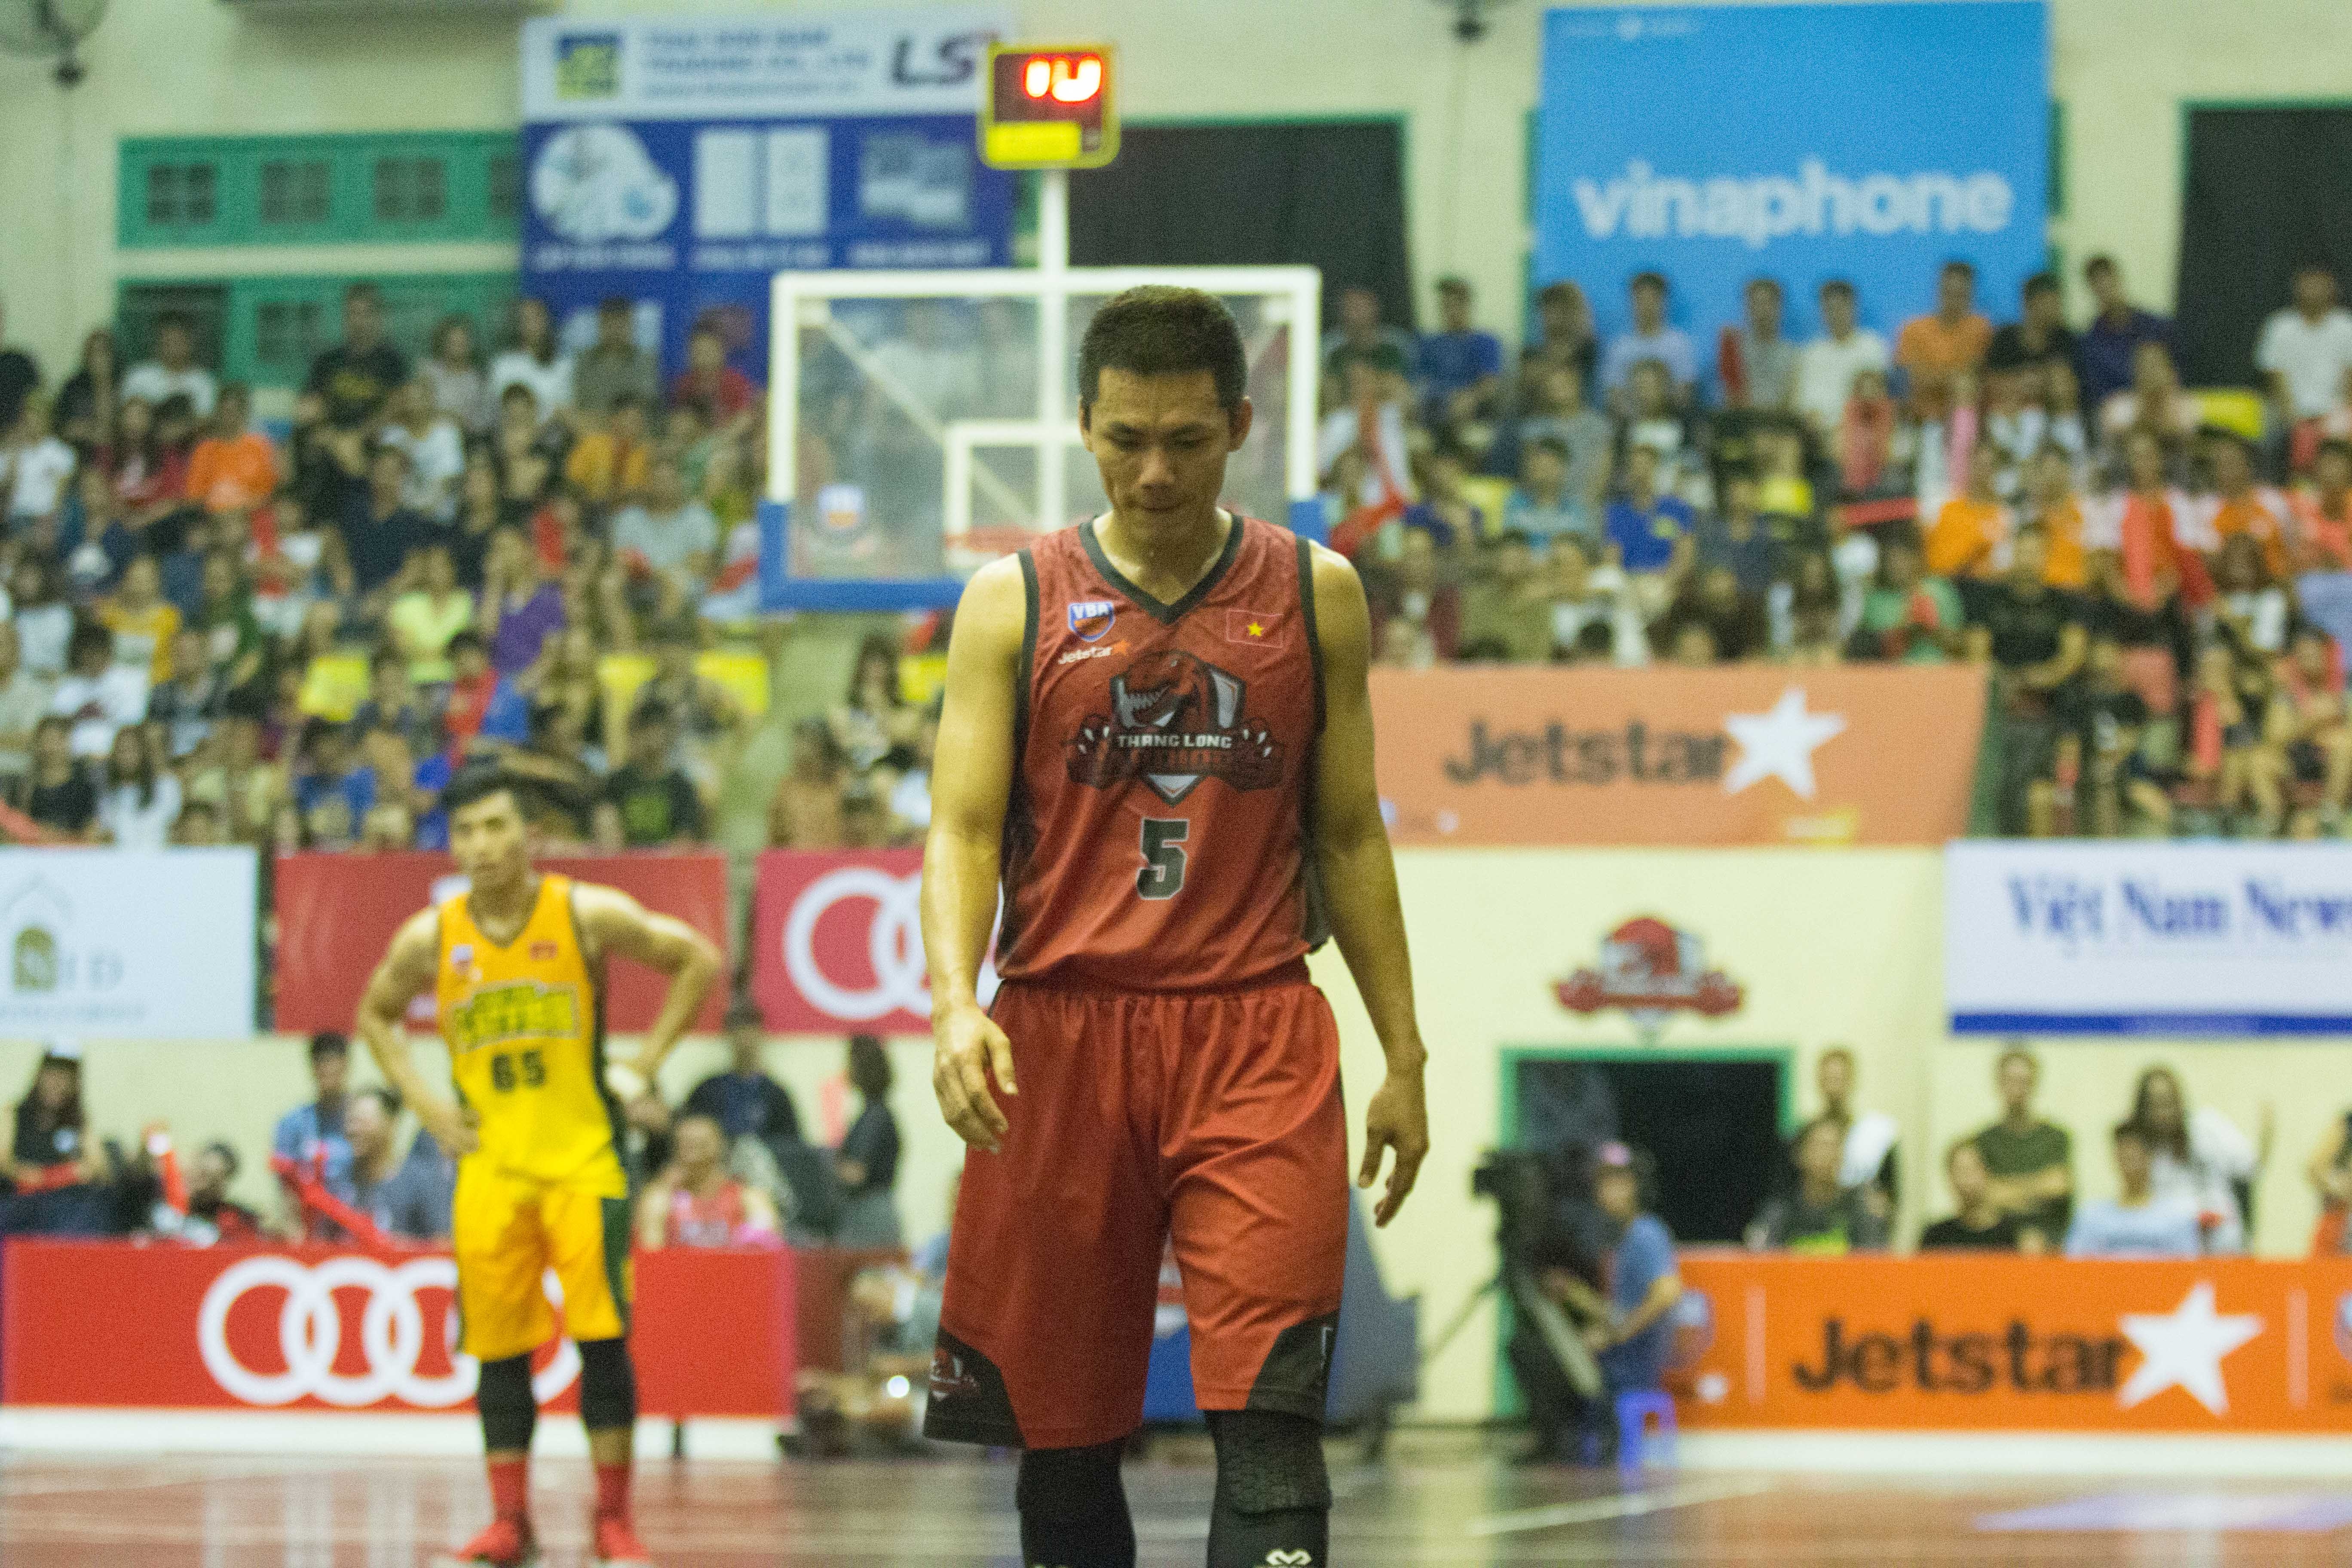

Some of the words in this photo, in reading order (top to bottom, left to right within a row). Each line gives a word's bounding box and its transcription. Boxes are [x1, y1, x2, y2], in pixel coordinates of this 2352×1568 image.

[1575, 159, 2014, 248] vinaphone
[1072, 604, 1110, 620] VBA
[1058, 646, 1112, 665] Jetstar
[1118, 734, 1179, 747] THANG
[1183, 734, 1232, 749] LONG
[1445, 720, 1724, 786] Jetstar
[1136, 817, 1190, 900] 5
[2119, 873, 2228, 934] Nam
[490, 1048, 547, 1093] 65
[1791, 1316, 2125, 1394] Jetstar
